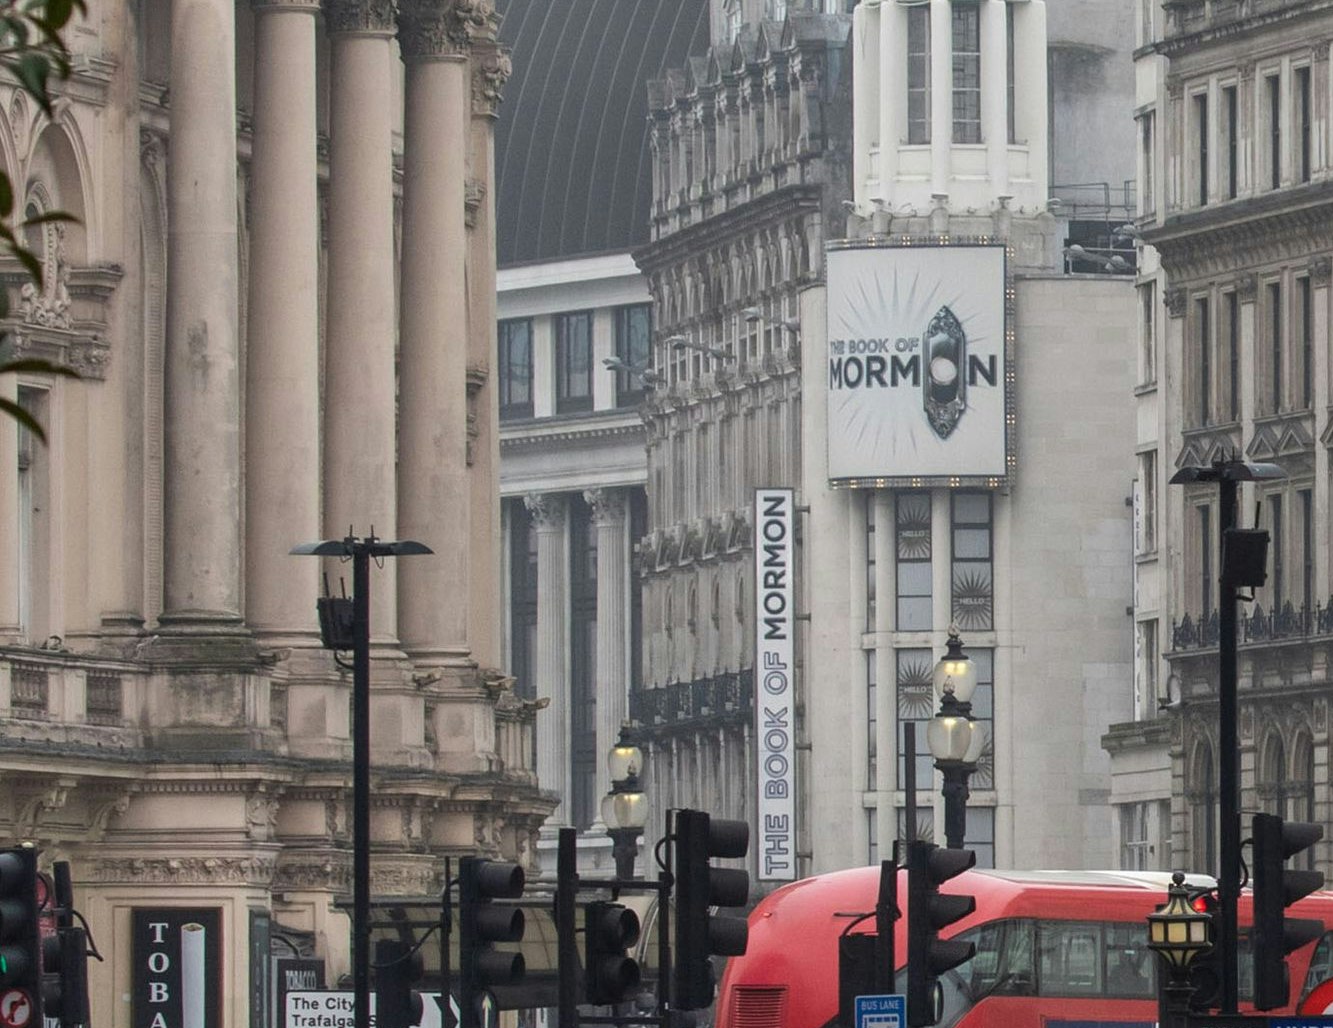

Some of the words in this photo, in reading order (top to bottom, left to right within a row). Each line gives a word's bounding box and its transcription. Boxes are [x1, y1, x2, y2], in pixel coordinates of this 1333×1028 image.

[848, 338, 889, 354] BOOK
[895, 337, 920, 353] OF
[829, 354, 998, 390] MORMON
[762, 495, 788, 640] MORMON
[763, 651, 788, 696] OF
[763, 706, 789, 800] BOOK
[764, 813, 790, 875] THE
[292, 997, 319, 1010] The
[325, 997, 355, 1013] City
[292, 1014, 355, 1028] Trafalga
[861, 1001, 878, 1011] BUS
[880, 1000, 900, 1010] LANE
